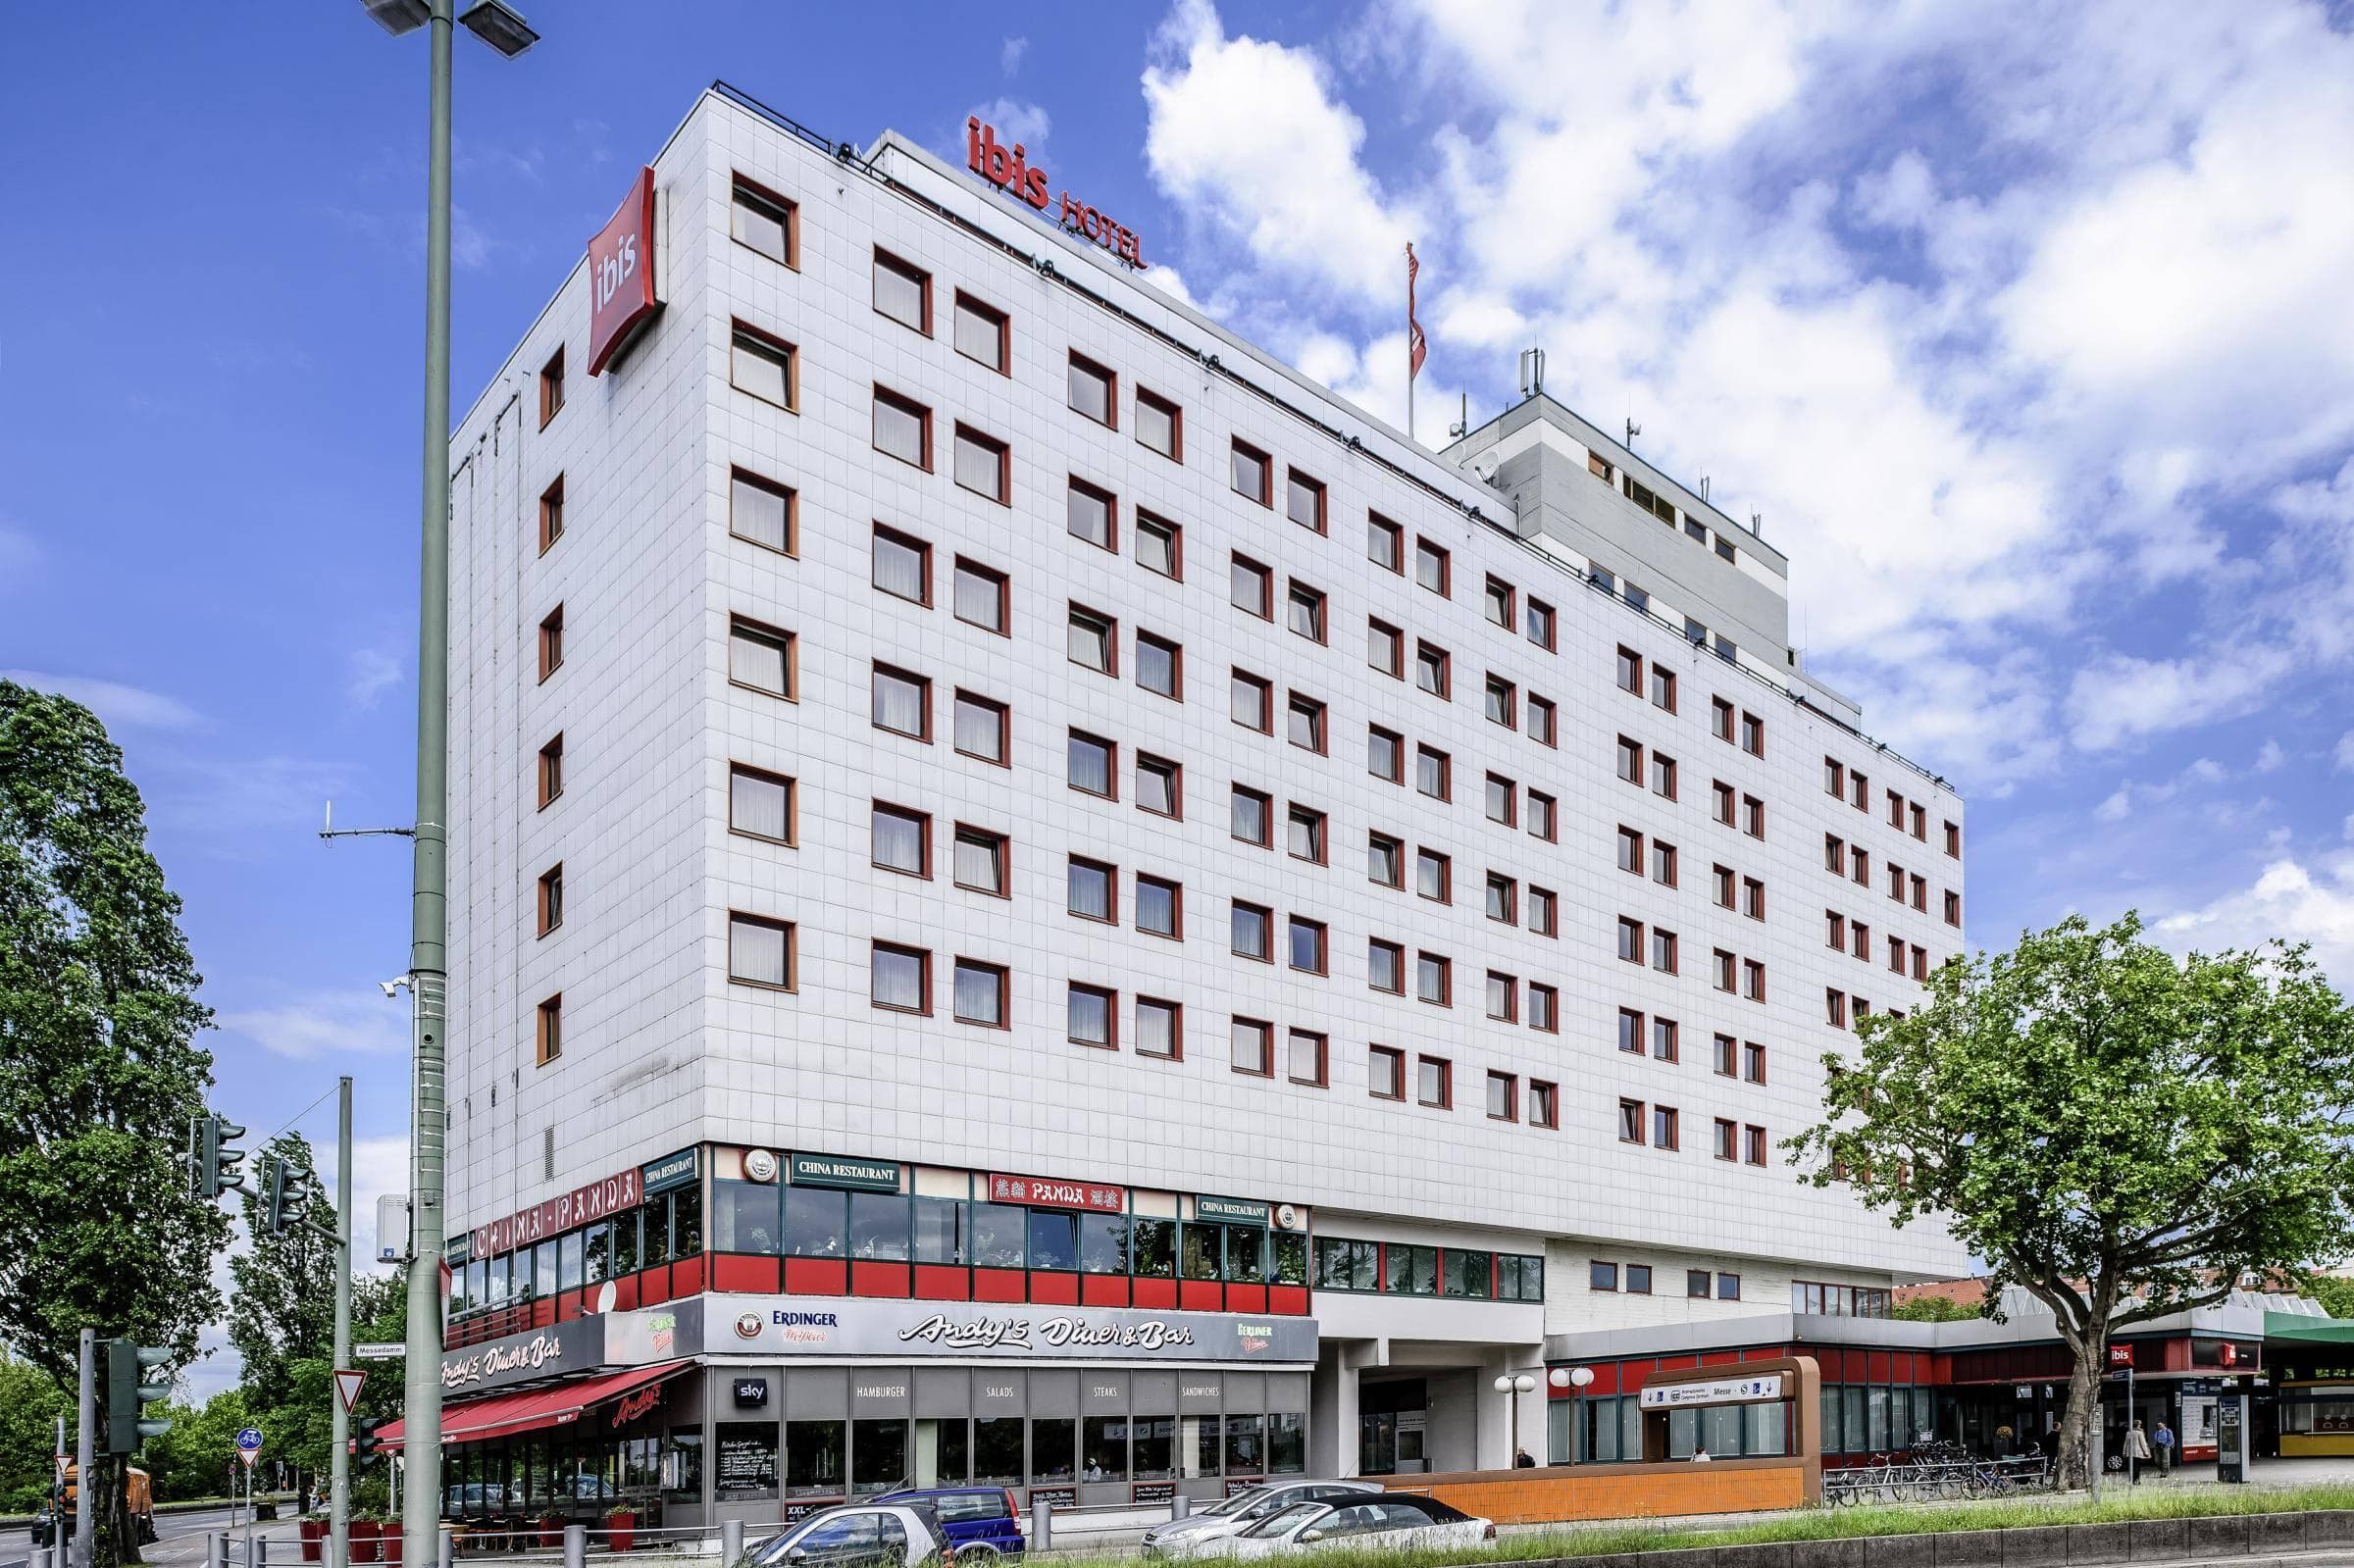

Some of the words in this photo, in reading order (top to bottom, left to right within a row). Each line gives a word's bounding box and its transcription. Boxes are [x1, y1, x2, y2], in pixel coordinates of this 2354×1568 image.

[967, 116, 1049, 211] ibis
[1060, 191, 1148, 270] HOTEL
[597, 233, 636, 315] ibis
[645, 1169, 661, 1184] CHINA
[661, 1157, 692, 1178] RESTAURANT
[799, 1161, 831, 1175] CHINA
[833, 1164, 895, 1181] RESTAURANT
[1032, 1183, 1085, 1204] PANDA
[477, 1211, 539, 1256] CHINA
[560, 1173, 637, 1226] PANDA
[1202, 1201, 1223, 1213] CHINA
[1224, 1204, 1265, 1217] RESTAURANT
[773, 1310, 838, 1327] ERDINGER
[898, 1314, 1032, 1350] Andy's
[1040, 1317, 1121, 1346] Diner
[1139, 1320, 1194, 1350] Bar
[2111, 1349, 2128, 1360] ibis
[741, 1384, 764, 1398] sky
[857, 1387, 905, 1397] HAMBURGER
[986, 1387, 1013, 1397] SALADS
[1094, 1387, 1117, 1397] STEAKS
[1182, 1387, 1219, 1396] SANDWICHES
[612, 1383, 661, 1428] Andy's
